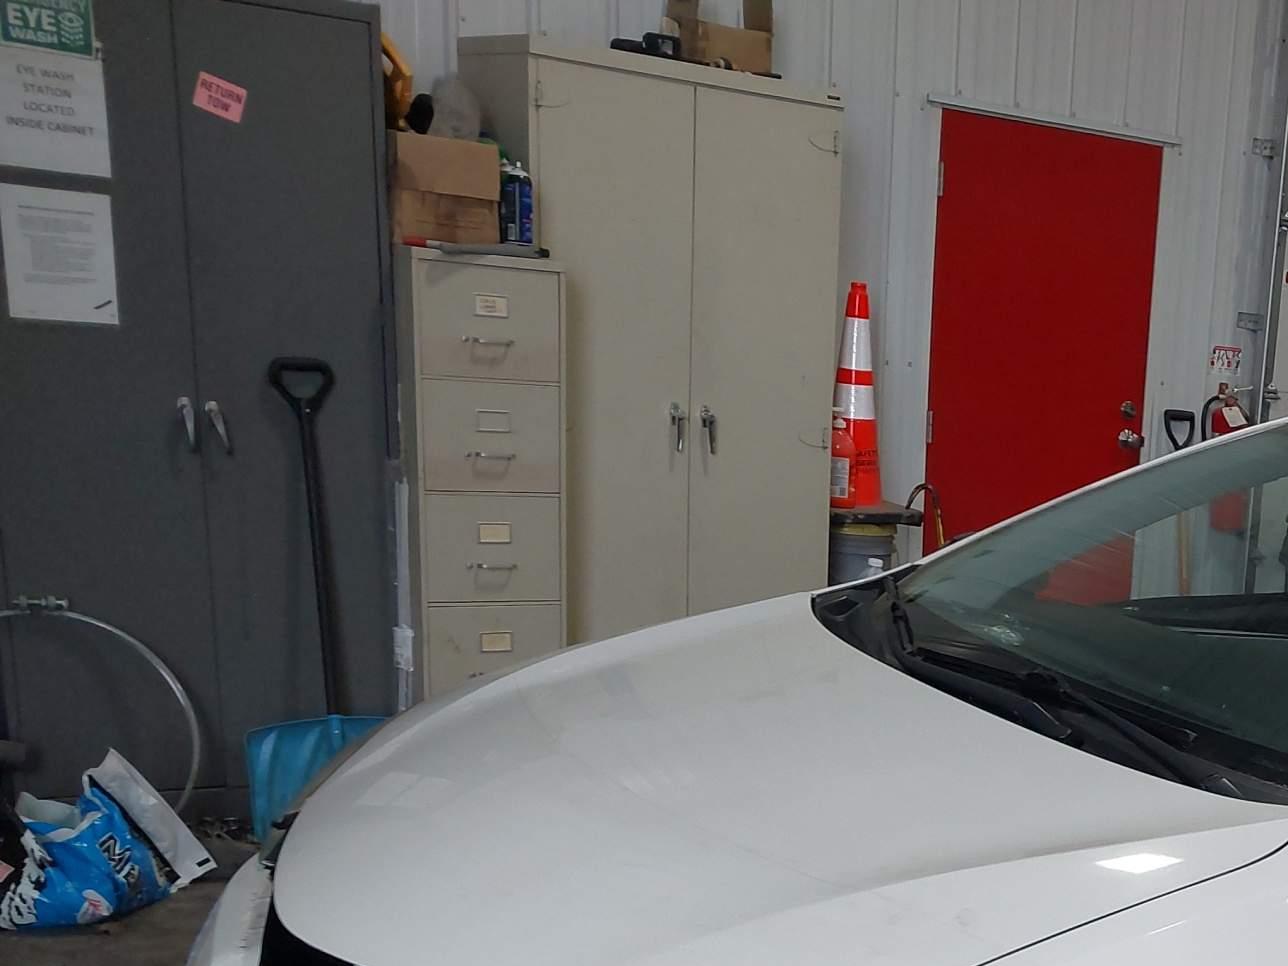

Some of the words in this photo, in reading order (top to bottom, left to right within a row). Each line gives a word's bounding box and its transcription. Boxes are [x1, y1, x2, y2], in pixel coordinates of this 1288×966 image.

[7, 2, 57, 32] EYE
[8, 26, 58, 44] WASH
[16, 64, 36, 76] EYE
[39, 69, 74, 80] WASH
[23, 82, 72, 98] STATION
[200, 78, 243, 105] RETURN
[23, 101, 75, 116] LOCATED
[207, 94, 232, 112] TOW
[47, 122, 94, 136] CABINET
